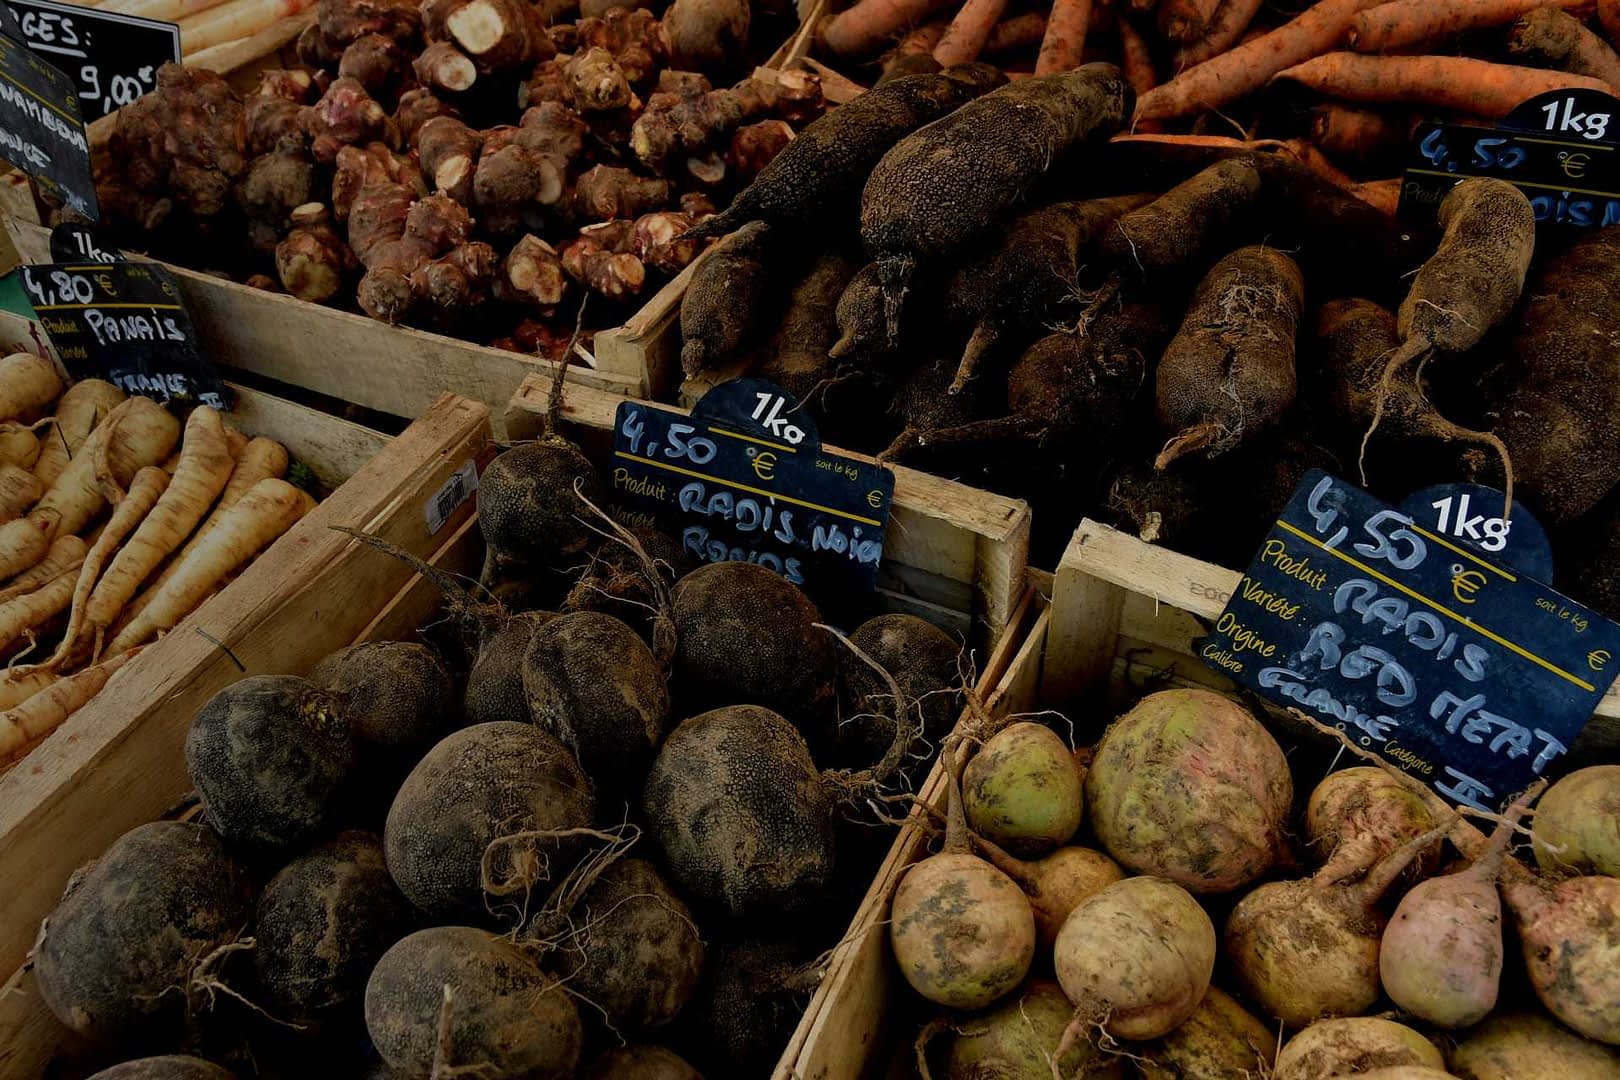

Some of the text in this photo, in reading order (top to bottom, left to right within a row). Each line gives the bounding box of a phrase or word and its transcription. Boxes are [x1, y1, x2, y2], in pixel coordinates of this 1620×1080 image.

[1541, 97, 1611, 140] 1kg
[23, 266, 94, 306] 4,80
[622, 410, 718, 465] 4,50
[1307, 475, 1428, 571] 4,50
[1431, 494, 1513, 552] 1kg
[1333, 578, 1492, 682] RADIS
[1429, 690, 1569, 775] MEAT
